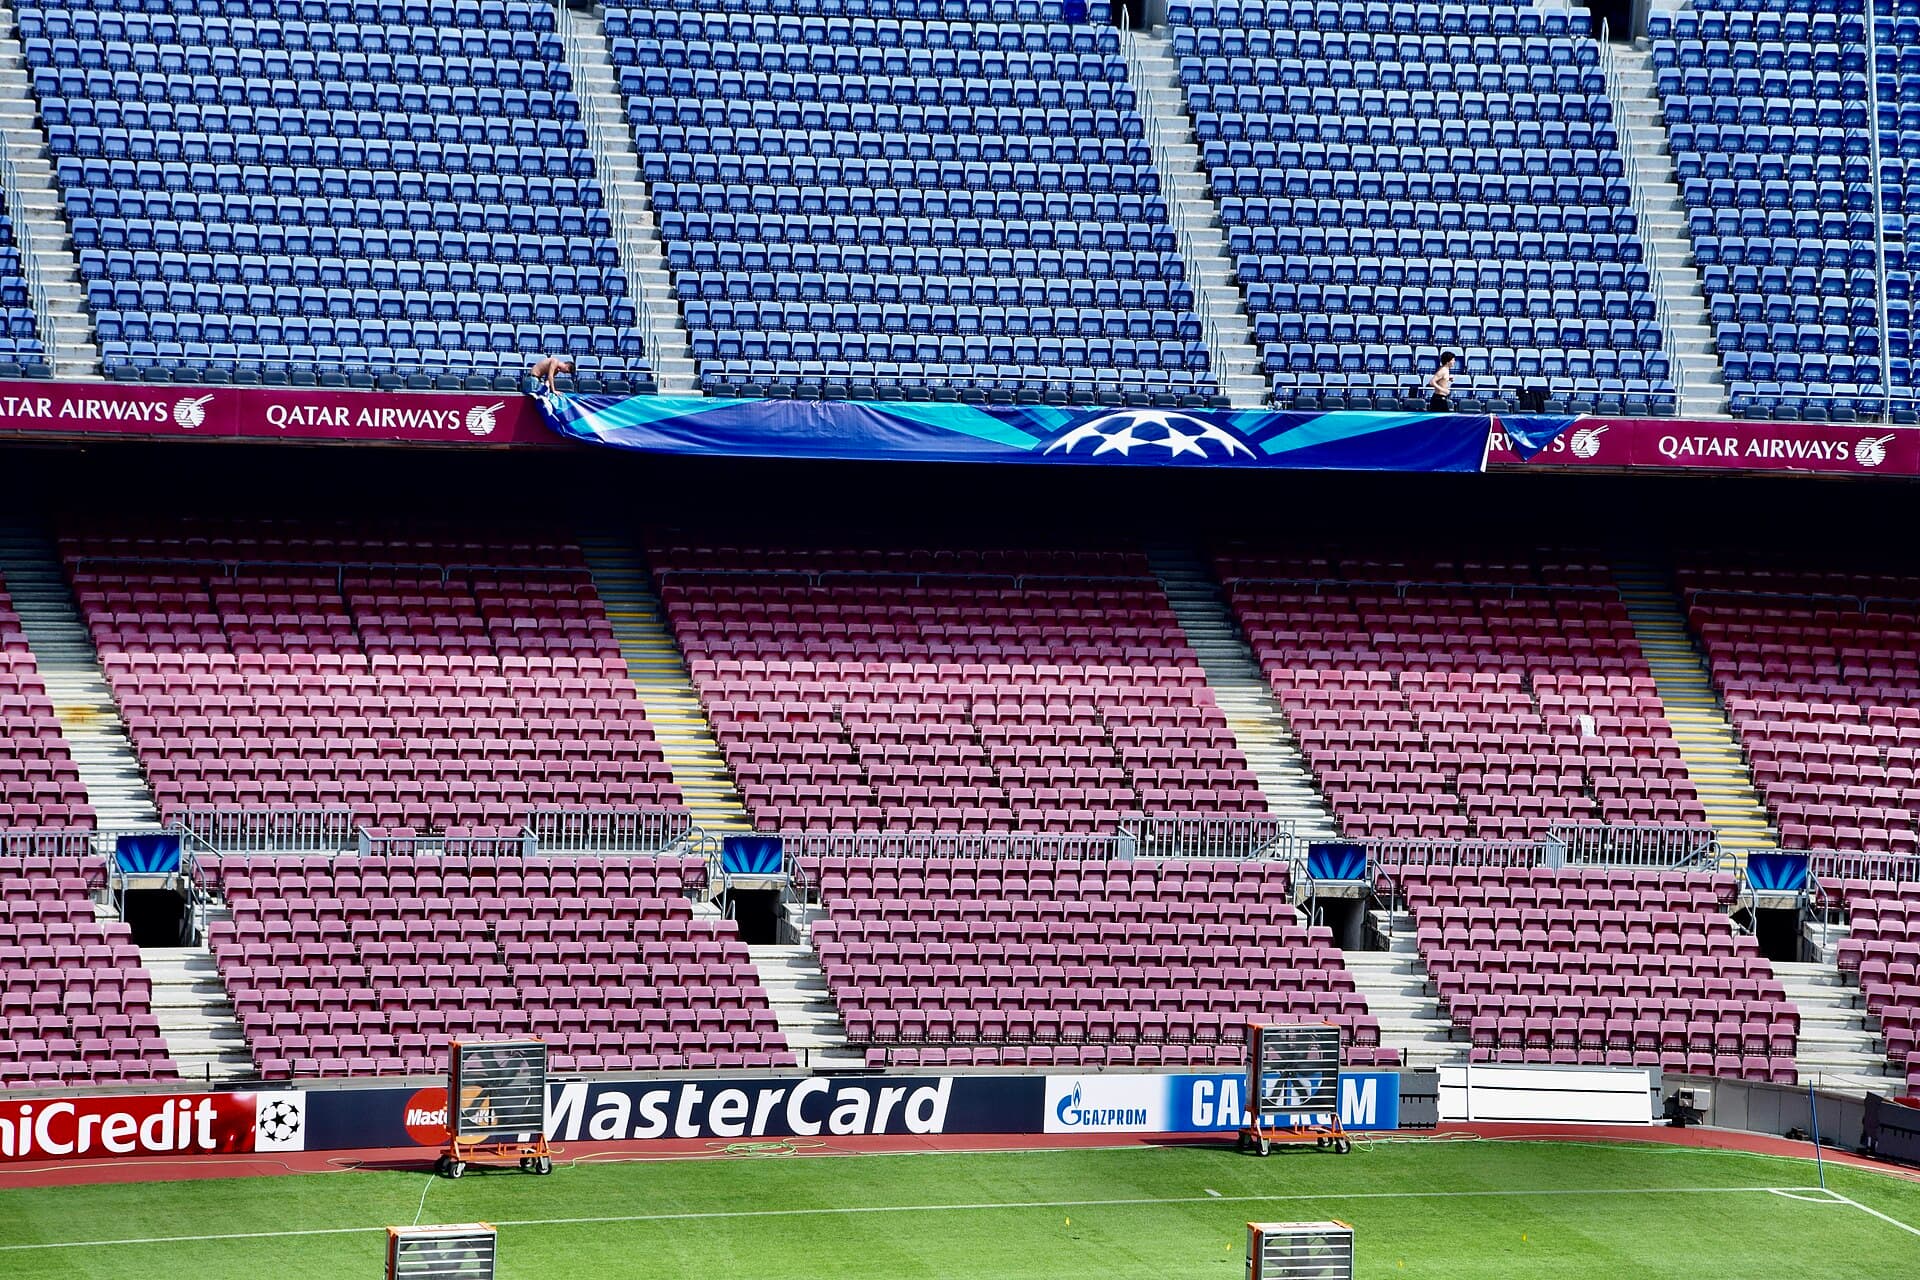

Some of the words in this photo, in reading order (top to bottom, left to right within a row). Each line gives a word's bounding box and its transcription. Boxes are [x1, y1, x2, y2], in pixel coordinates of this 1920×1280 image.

[59, 398, 168, 422] AIRWAYS
[266, 404, 350, 429] QATAR
[356, 407, 460, 430] AIRWAYS
[1658, 435, 1739, 459] QATAR
[1744, 438, 1849, 460] AIRWAYS
[518, 1077, 953, 1142] MasterCard
[1083, 1108, 1147, 1126] GAZPROM
